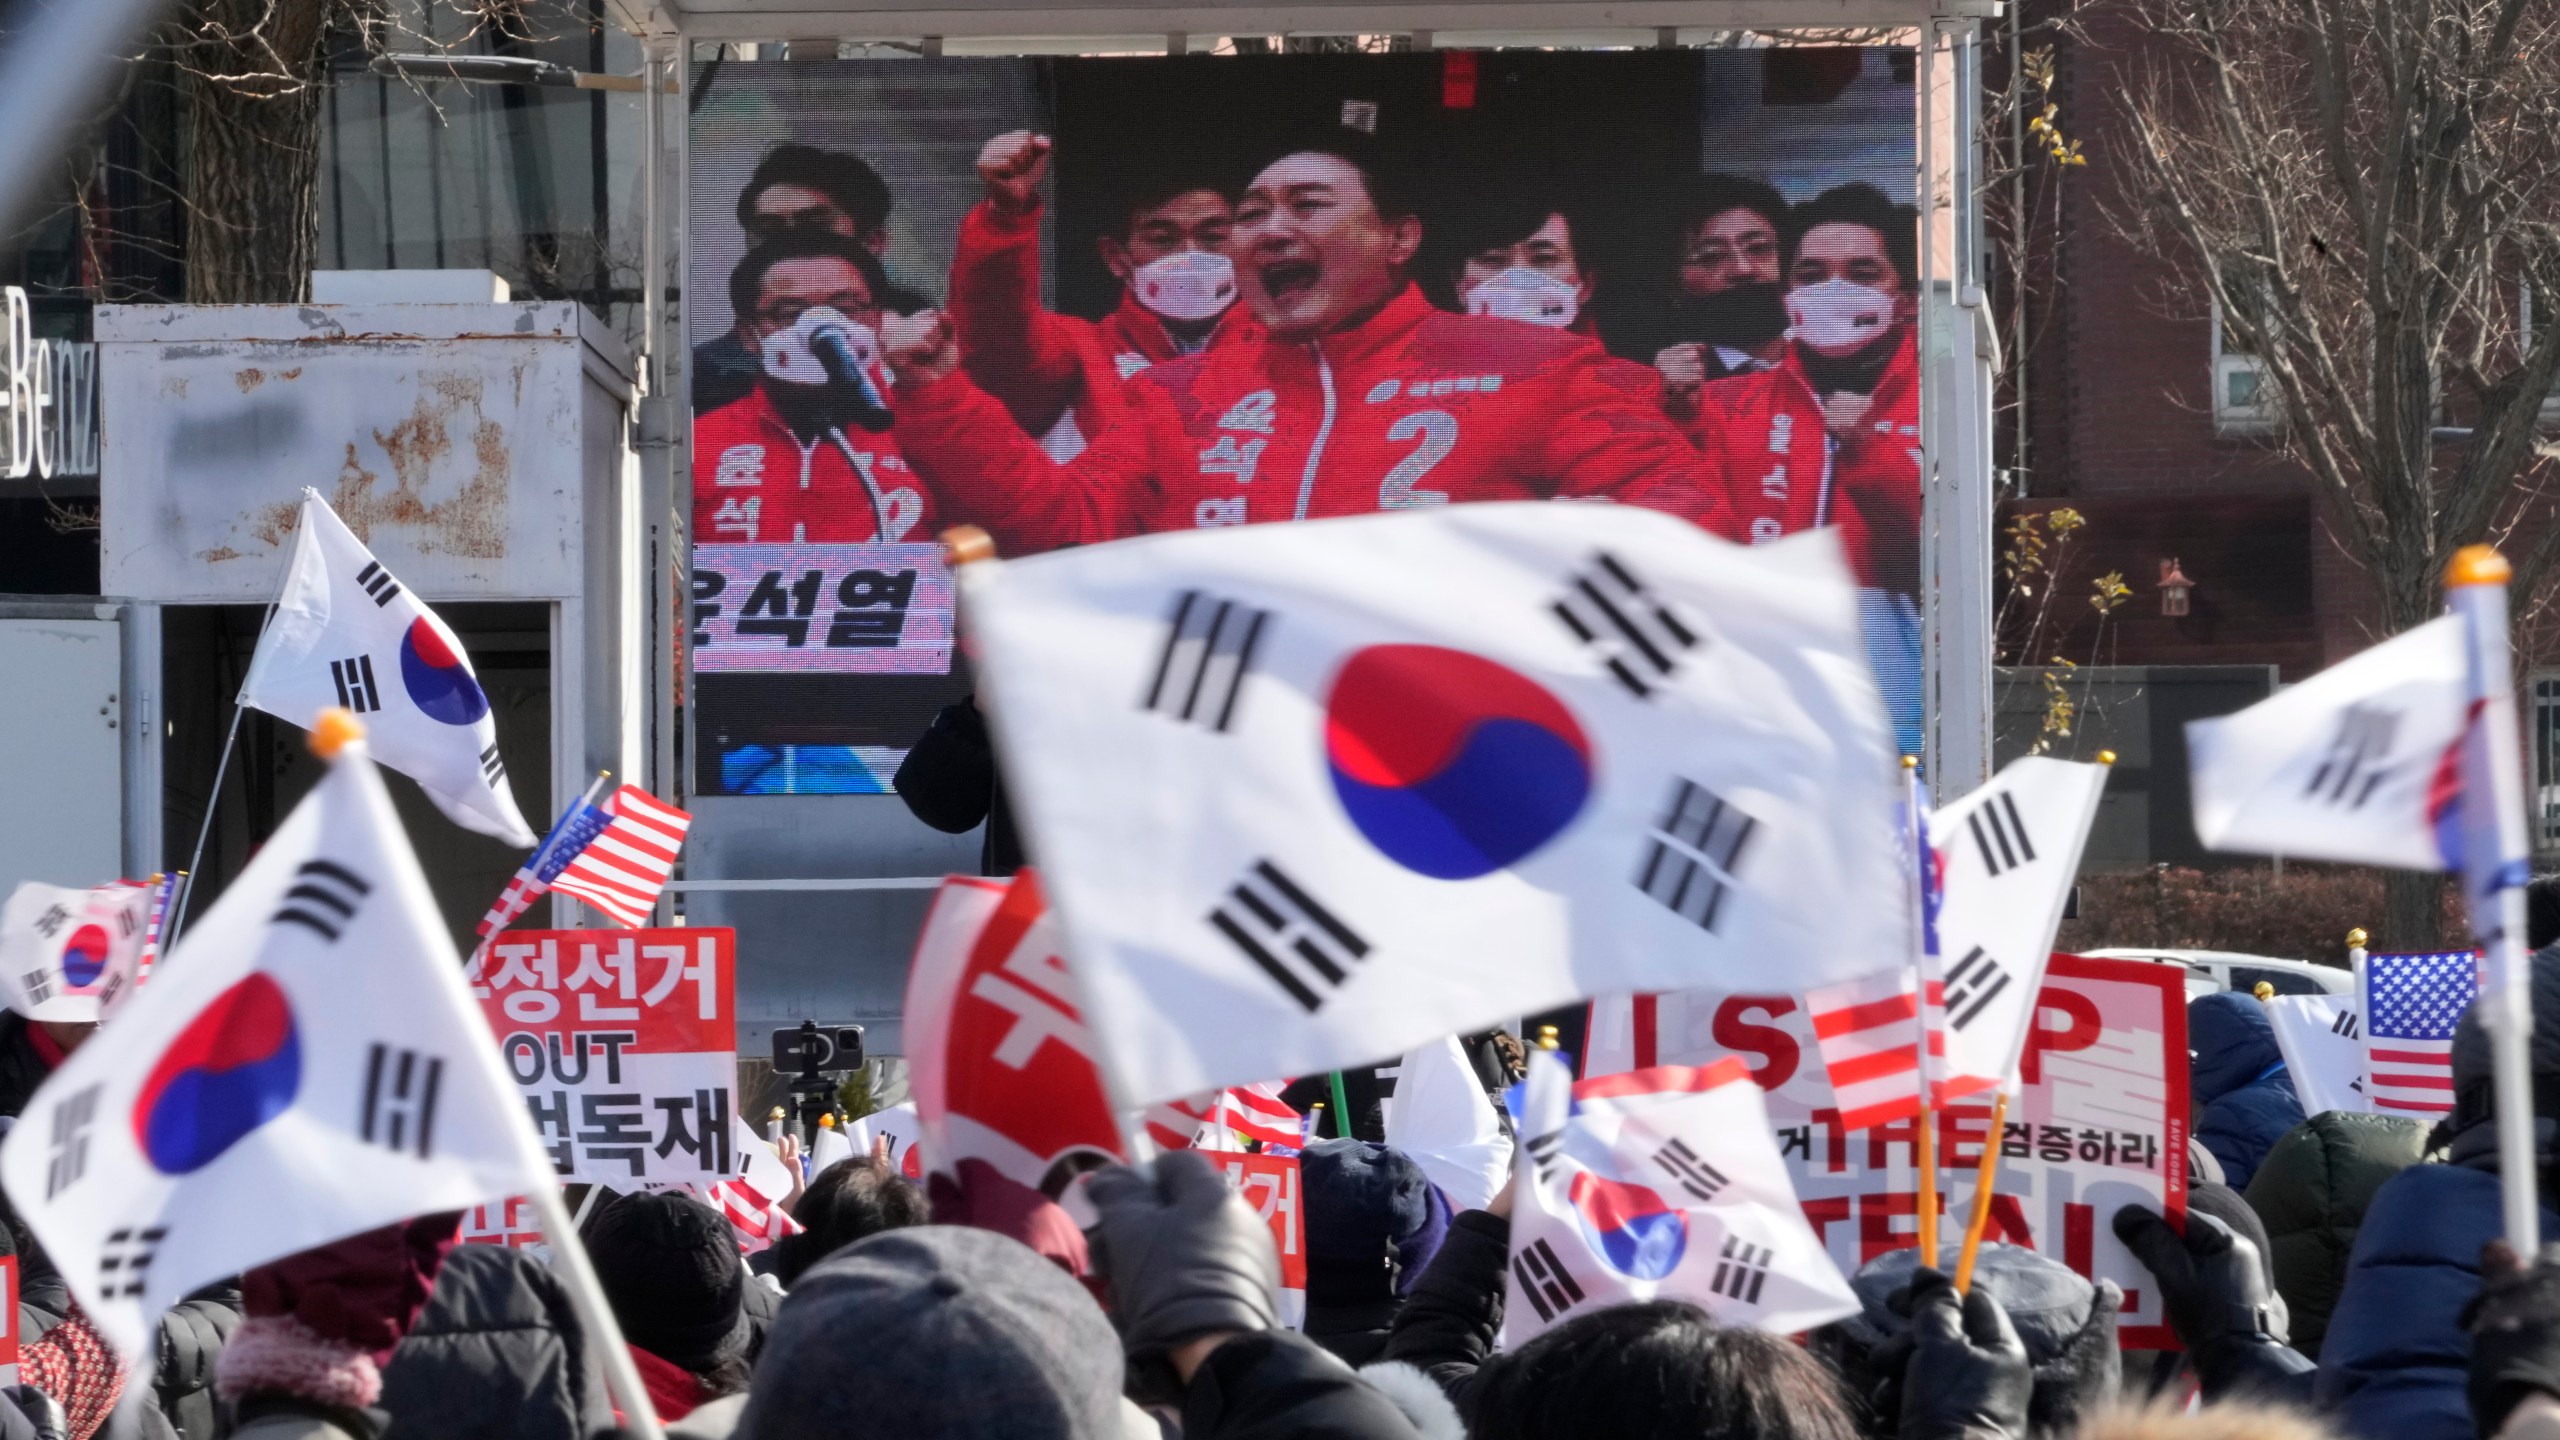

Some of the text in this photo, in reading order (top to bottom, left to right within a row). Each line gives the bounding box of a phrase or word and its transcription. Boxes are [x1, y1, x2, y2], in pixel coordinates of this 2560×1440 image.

[1379, 410, 1458, 510] 2
[476, 937, 717, 1023] 정선거
[502, 1031, 637, 1086] OUT
[2000, 1122, 2158, 1169] 검증하라
[2169, 1118, 2181, 1192] SAVE KOREA
